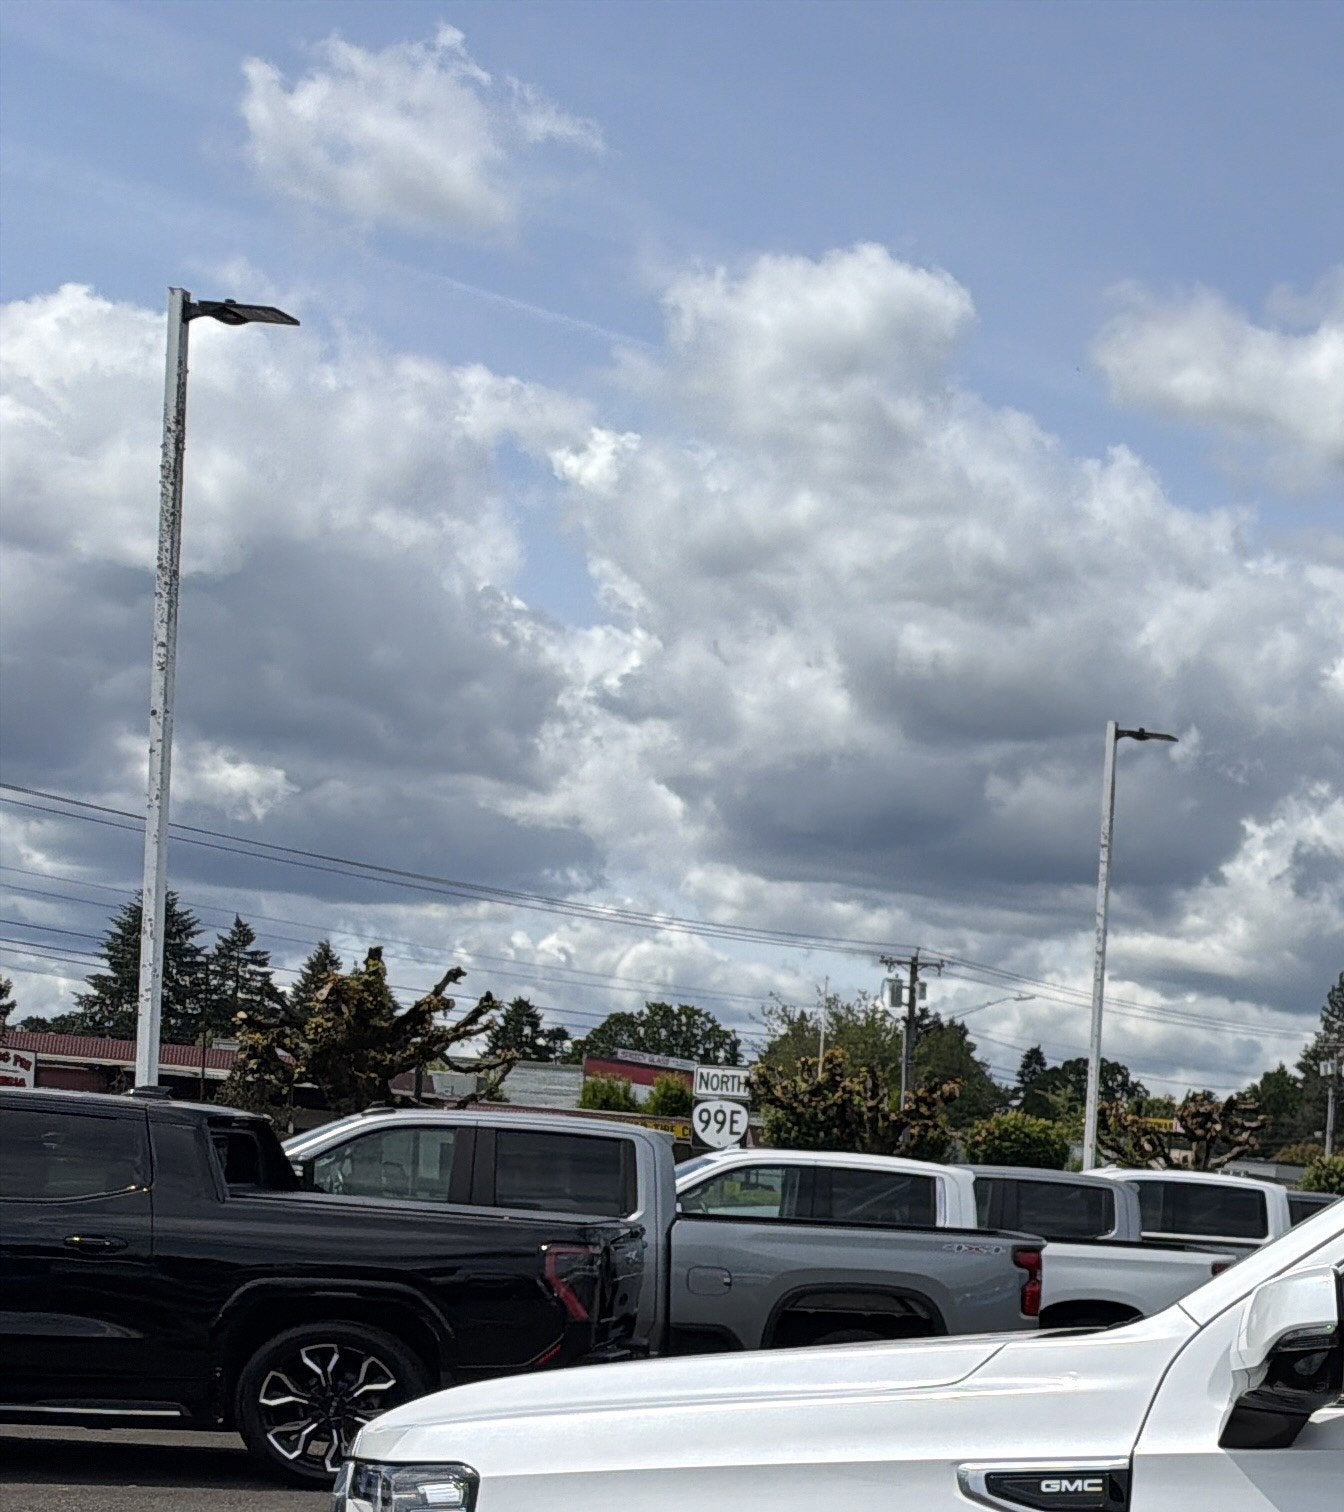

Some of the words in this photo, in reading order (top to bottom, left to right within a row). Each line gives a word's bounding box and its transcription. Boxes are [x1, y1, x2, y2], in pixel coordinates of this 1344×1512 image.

[699, 1071, 749, 1093] NORTH
[698, 1108, 742, 1136] 99E
[1040, 1479, 1103, 1493] GMC
